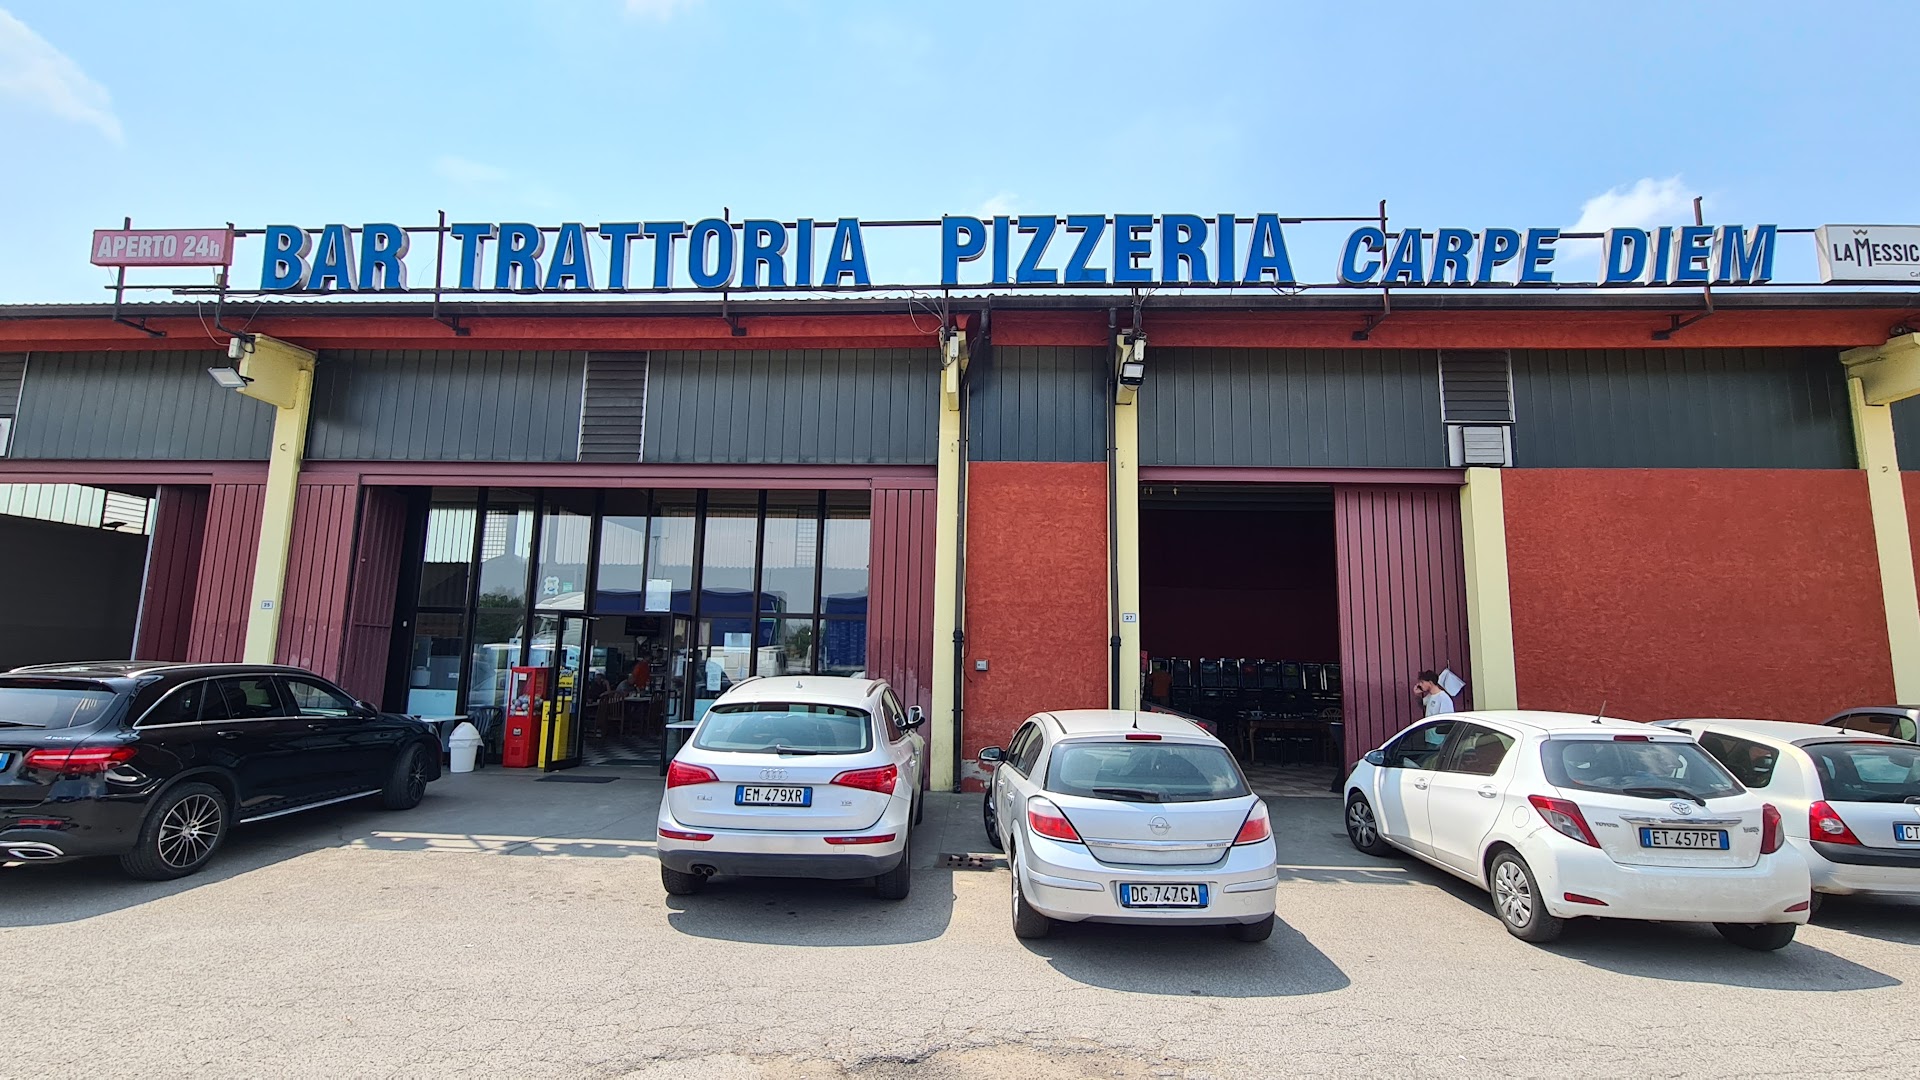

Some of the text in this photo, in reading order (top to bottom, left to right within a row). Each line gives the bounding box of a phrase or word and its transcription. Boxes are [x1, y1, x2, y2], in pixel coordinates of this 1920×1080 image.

[97, 235, 220, 258] APERTO 24h
[260, 214, 1778, 290] BAR TRATTORIA PIZZERIA CARPE DIEM
